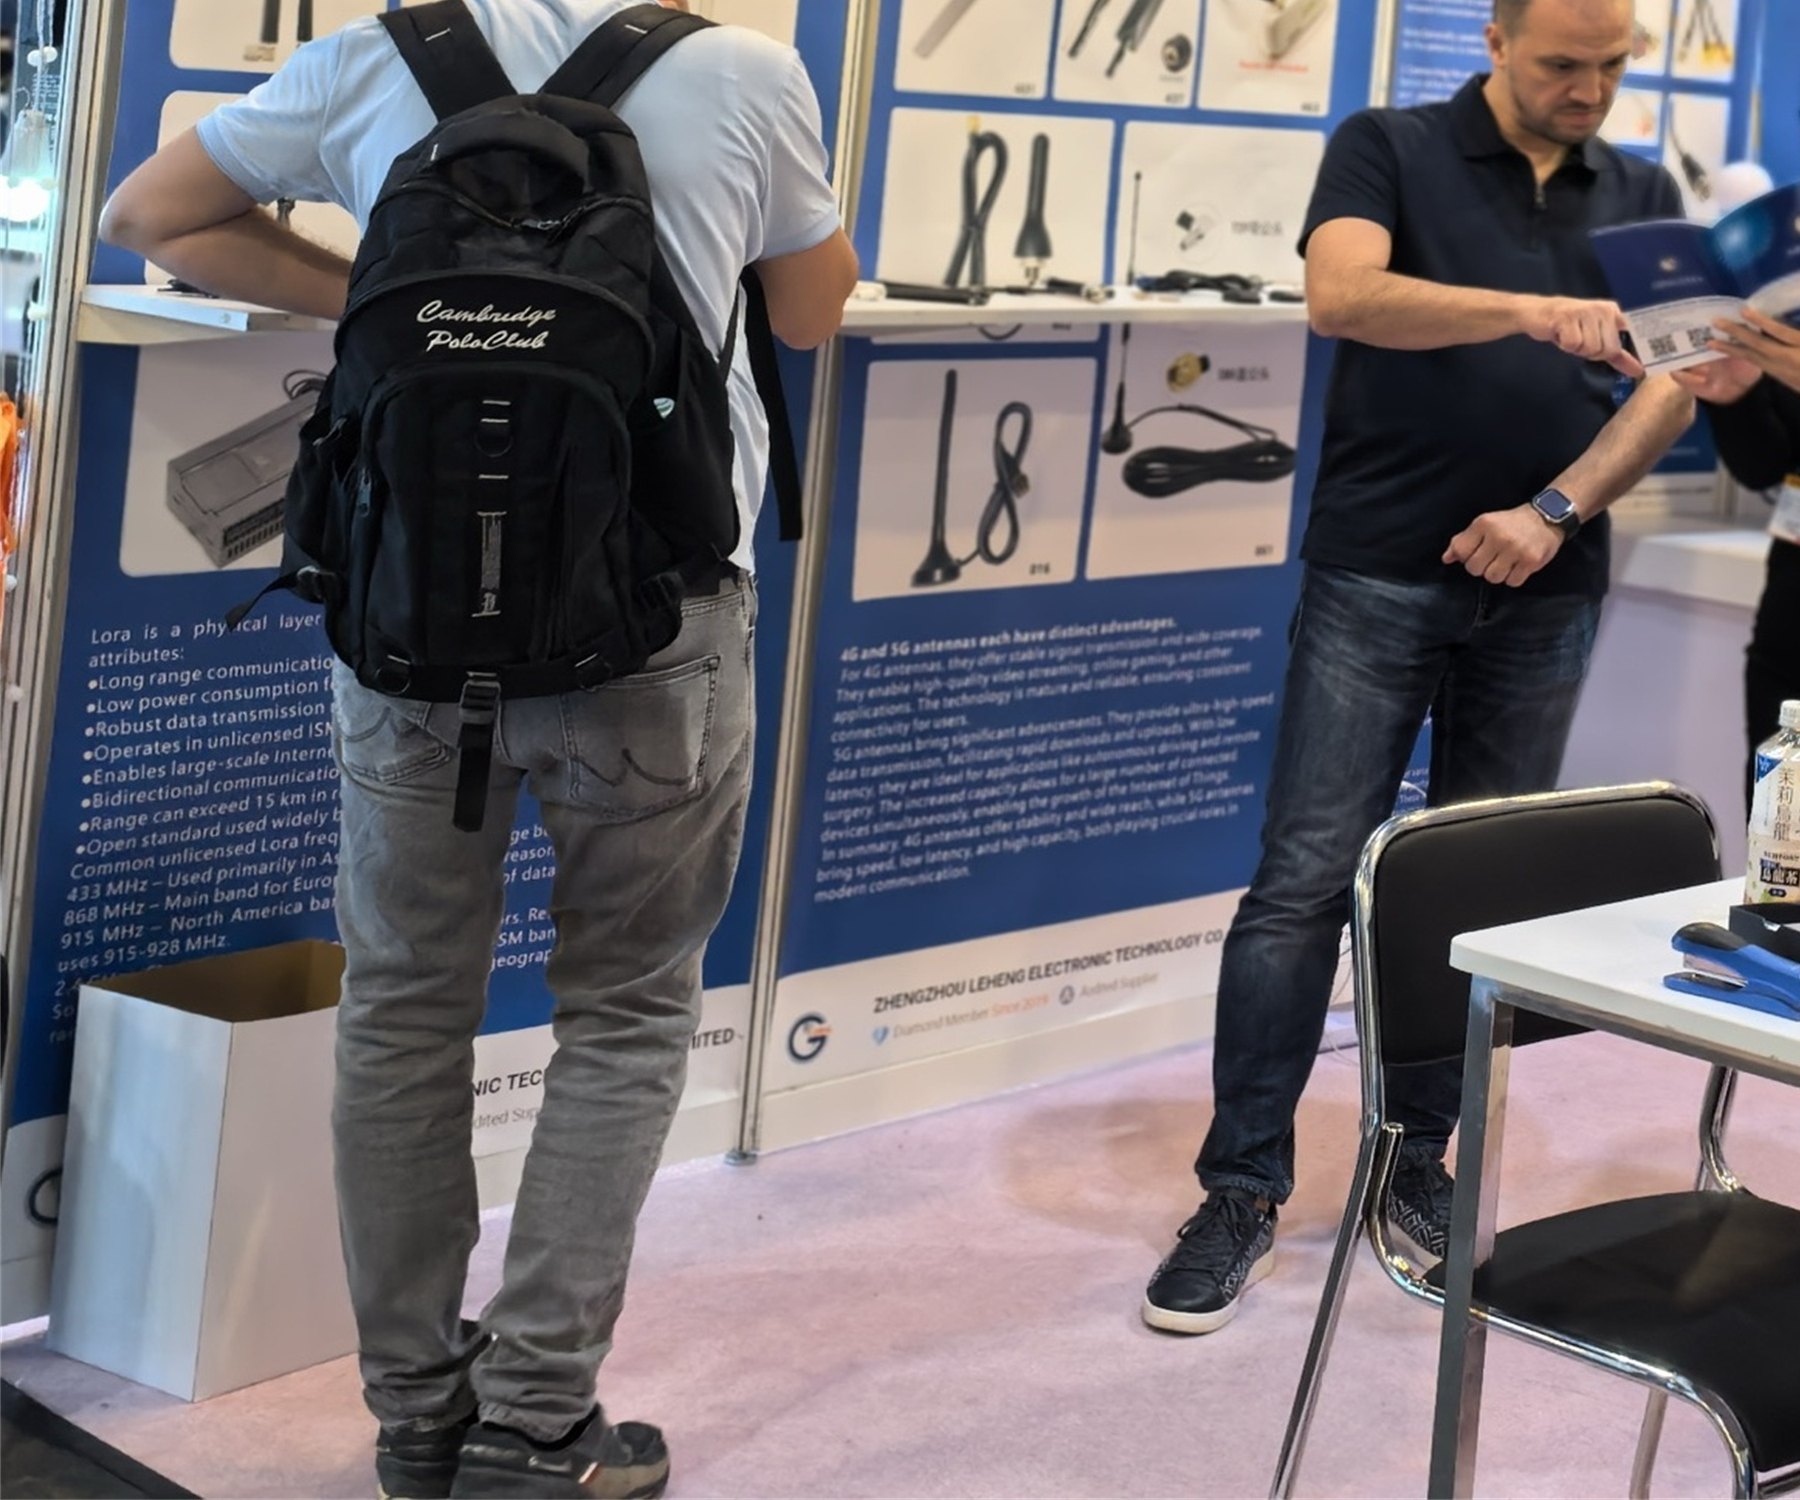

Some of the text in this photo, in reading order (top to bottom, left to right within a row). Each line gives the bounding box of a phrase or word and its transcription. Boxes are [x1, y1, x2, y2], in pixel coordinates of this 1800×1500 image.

[416, 300, 557, 328] Cambridge
[92, 614, 320, 644] Lora is a phyical layer
[840, 618, 1174, 661] 4G and 5G antennas each have distinct advantages.
[89, 647, 183, 667] attributes:
[98, 654, 333, 690] Long range communicatio
[96, 680, 318, 713] Low power consumption
[95, 702, 324, 736] Robust data transmission
[93, 724, 303, 763] Operates in unlicensed
[92, 762, 338, 808] Bidirectional communicatio
[93, 765, 165, 784] Enables
[171, 753, 269, 777] large-scale
[90, 788, 326, 831] Range can exceed 15 km in
[86, 809, 328, 856] Open standard used widely
[70, 830, 338, 879] Common unlicensed Lora freq
[67, 855, 316, 901] 433 MHz Used primarily in
[521, 865, 556, 882] data
[63, 906, 97, 925] 868
[103, 901, 144, 919] MHz
[164, 893, 208, 910] Main
[212, 885, 258, 903] band
[263, 881, 288, 895] for
[60, 929, 94, 949] 915
[102, 923, 143, 941] MHz
[170, 910, 223, 931] North
[230, 901, 302, 922] America
[497, 928, 556, 948] SM ban
[57, 954, 98, 972] uses
[103, 940, 180, 964] 915-928
[873, 980, 966, 1013] ZHENGZHOU
[968, 968, 1025, 993] LEHENG
[1027, 950, 1112, 981] ELECTRONIC
[1114, 933, 1202, 962] TECHNOLOGY
[691, 1027, 735, 1050] ITED
[507, 1069, 542, 1090] TEC
